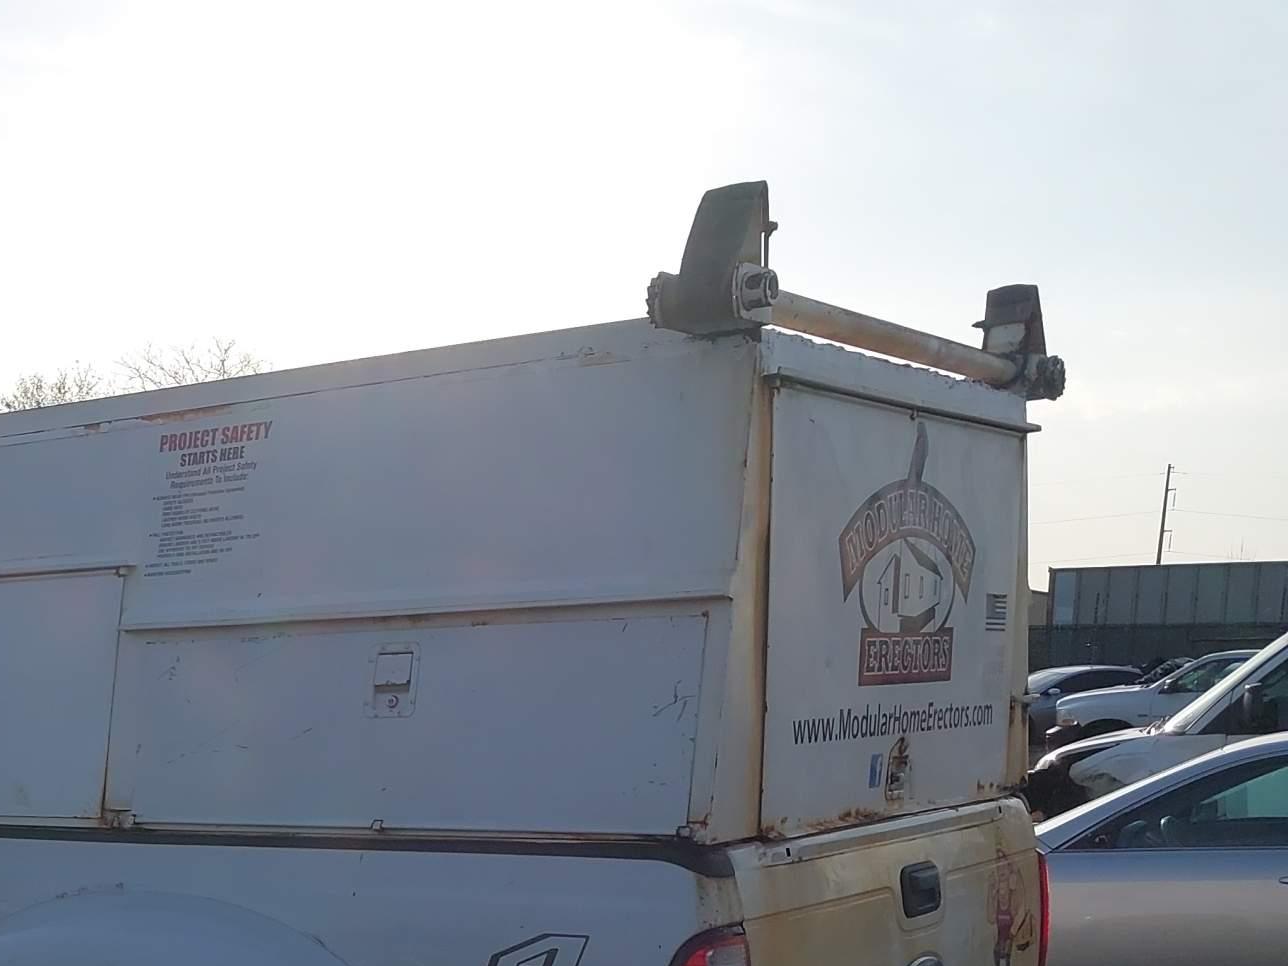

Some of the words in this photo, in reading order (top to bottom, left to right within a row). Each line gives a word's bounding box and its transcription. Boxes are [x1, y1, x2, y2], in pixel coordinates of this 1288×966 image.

[160, 428, 219, 453] PROJECT
[221, 420, 273, 445] SAFETY
[180, 449, 218, 467] STARTS
[219, 446, 245, 461] HERE
[844, 489, 930, 575] MODULAR
[929, 497, 975, 582] HOME
[863, 636, 951, 676] ERECTORS
[792, 701, 993, 746] www.ModularHomeErectors.com
